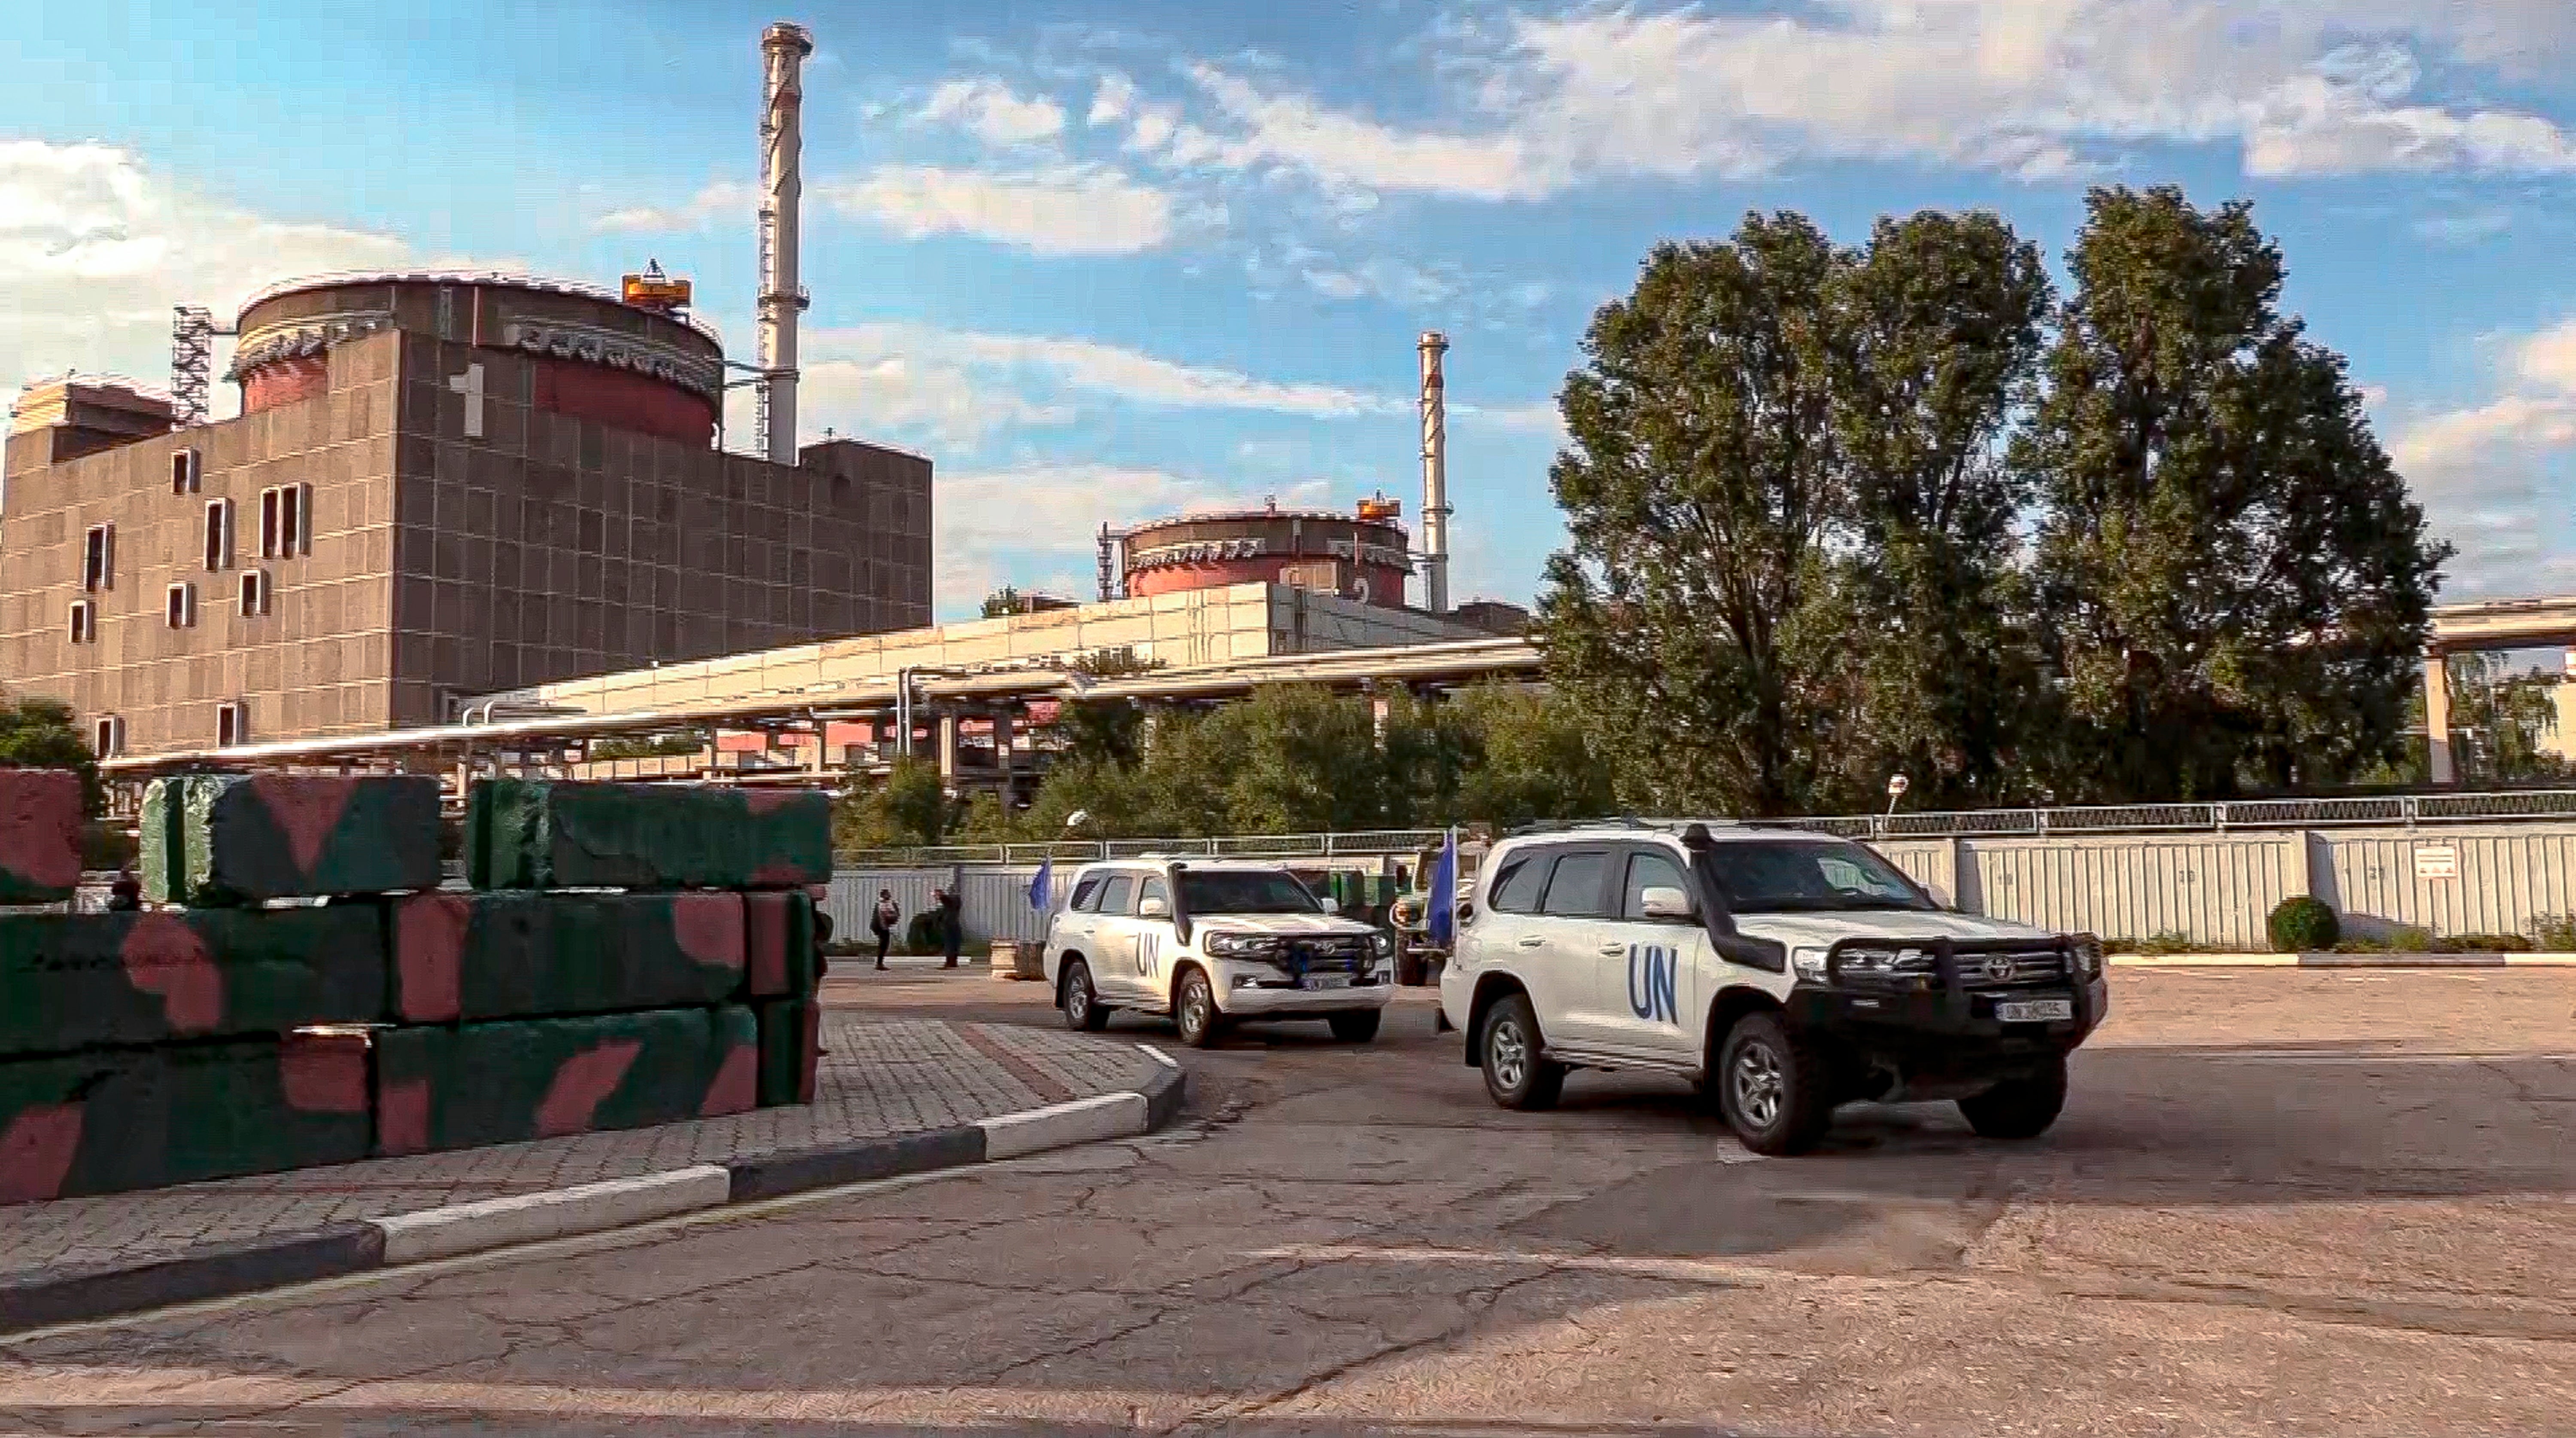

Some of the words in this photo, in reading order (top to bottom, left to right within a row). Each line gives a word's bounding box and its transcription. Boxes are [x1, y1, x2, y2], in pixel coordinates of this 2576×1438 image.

[449, 364, 484, 436] 1
[1136, 932, 1160, 978] UN
[1628, 943, 1678, 1025] UN
